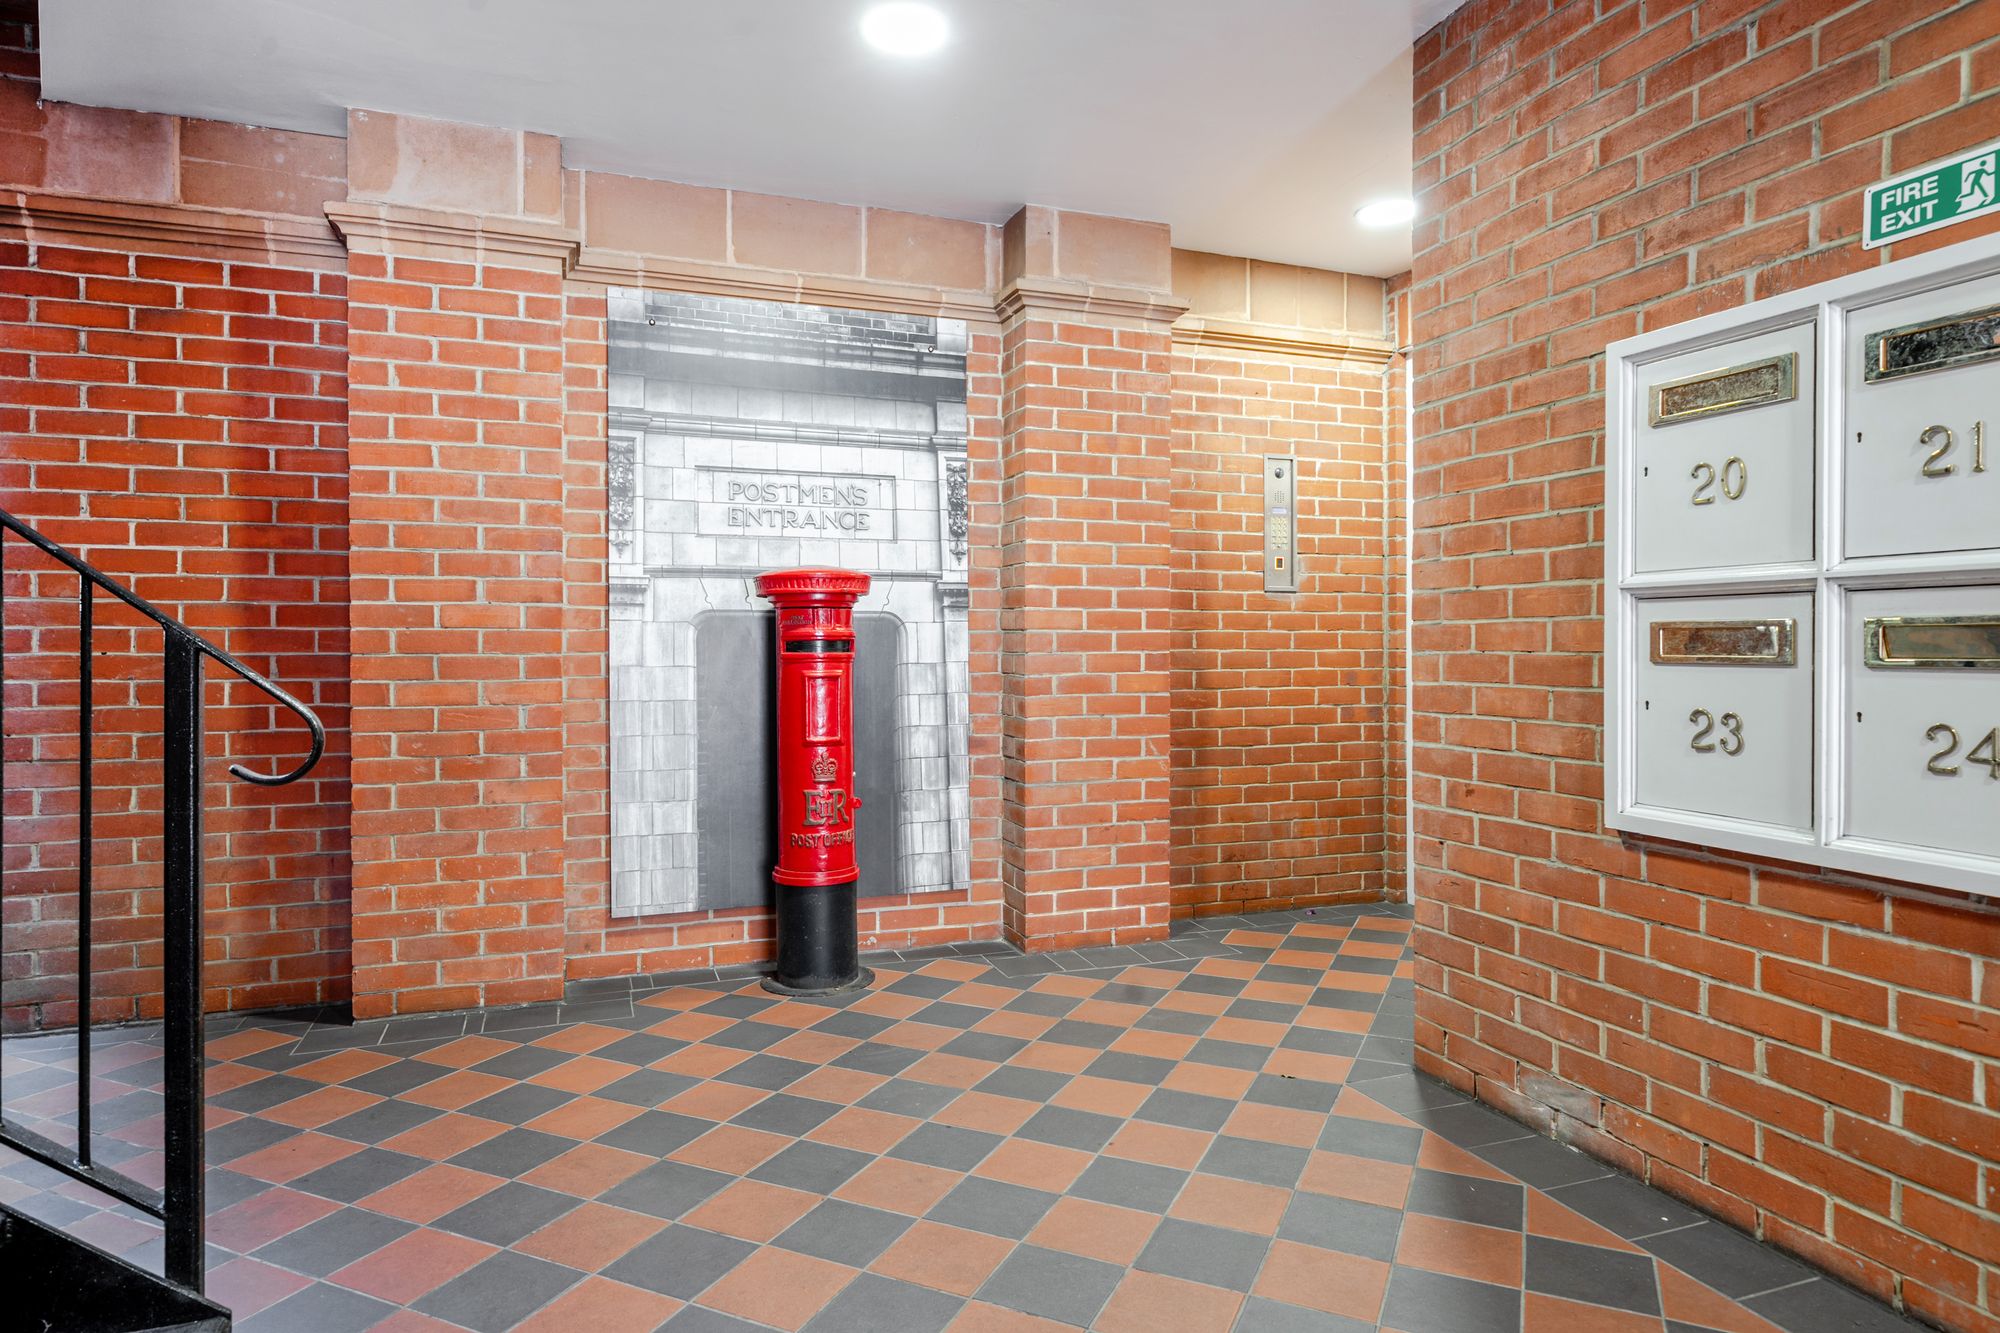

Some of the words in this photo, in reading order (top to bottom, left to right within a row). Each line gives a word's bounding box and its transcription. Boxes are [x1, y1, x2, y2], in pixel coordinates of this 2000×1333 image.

[1881, 175, 1939, 211] FIRE
[1881, 199, 1939, 234] EXIT
[1920, 420, 1985, 478] 21
[1690, 456, 1747, 505] 20
[727, 506, 870, 531] ENTRANCE
[1689, 708, 1744, 756] 23
[1926, 723, 2000, 780] 24
[791, 833, 820, 847] POST
